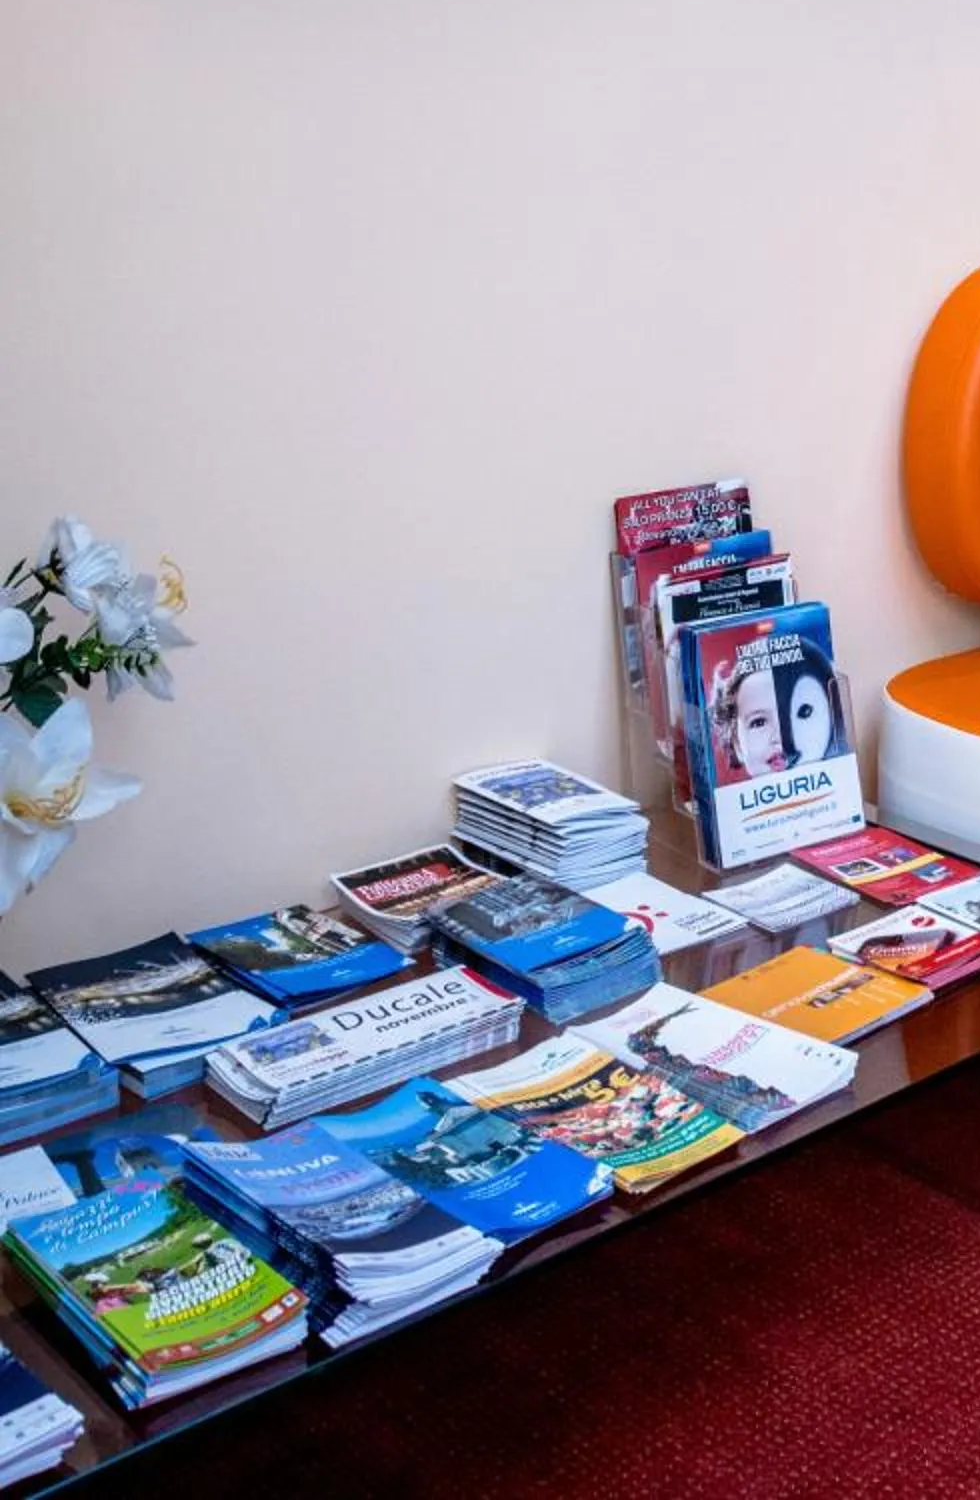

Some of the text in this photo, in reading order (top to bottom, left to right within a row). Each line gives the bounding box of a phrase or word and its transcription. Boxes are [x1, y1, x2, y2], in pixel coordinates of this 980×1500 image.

[740, 772, 832, 810] LIGURIA
[332, 981, 466, 1032] Ducale
[375, 997, 468, 1033] novembre
